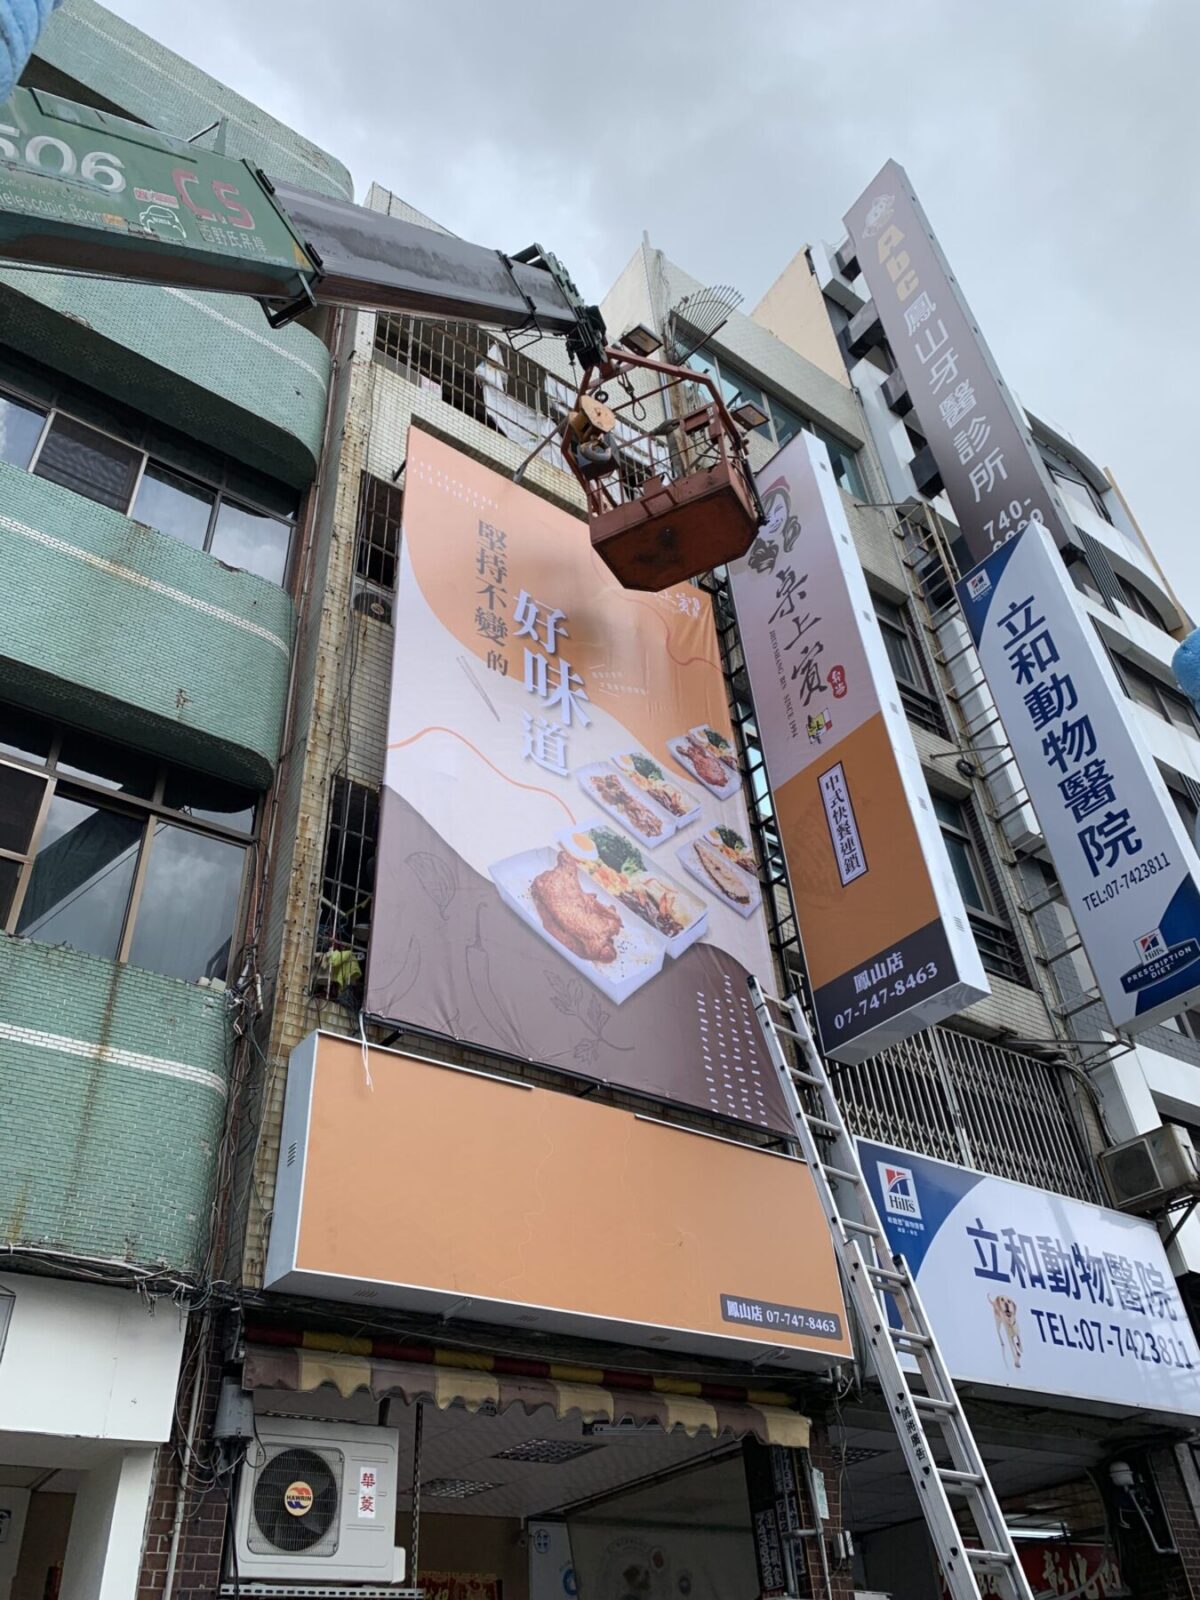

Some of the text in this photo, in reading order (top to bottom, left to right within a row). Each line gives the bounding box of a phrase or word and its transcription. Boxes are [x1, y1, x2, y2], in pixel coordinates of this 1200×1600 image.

[903, 291, 1009, 503] 鳳山牙醫診所
[983, 498, 1032, 542] 740-
[474, 518, 509, 677] 堅持不變的
[513, 588, 593, 777] 好味道
[996, 594, 1144, 879] 立和動物醫院
[824, 774, 862, 876] 中式快餐連鎖
[1082, 852, 1172, 912] TEL:07-7423811
[833, 961, 938, 1030] 07-747-8463
[853, 951, 906, 994] 鳳山店
[1127, 945, 1192, 985] PRESCRIPTION
[889, 1194, 916, 1213] Hill's
[966, 1217, 1178, 1322] 立和動物醫院
[726, 1299, 837, 1333] 鳳山店 07-747-8463
[1030, 1308, 1195, 1370] TEL:07-7423811
[360, 1472, 376, 1514] 華菱
